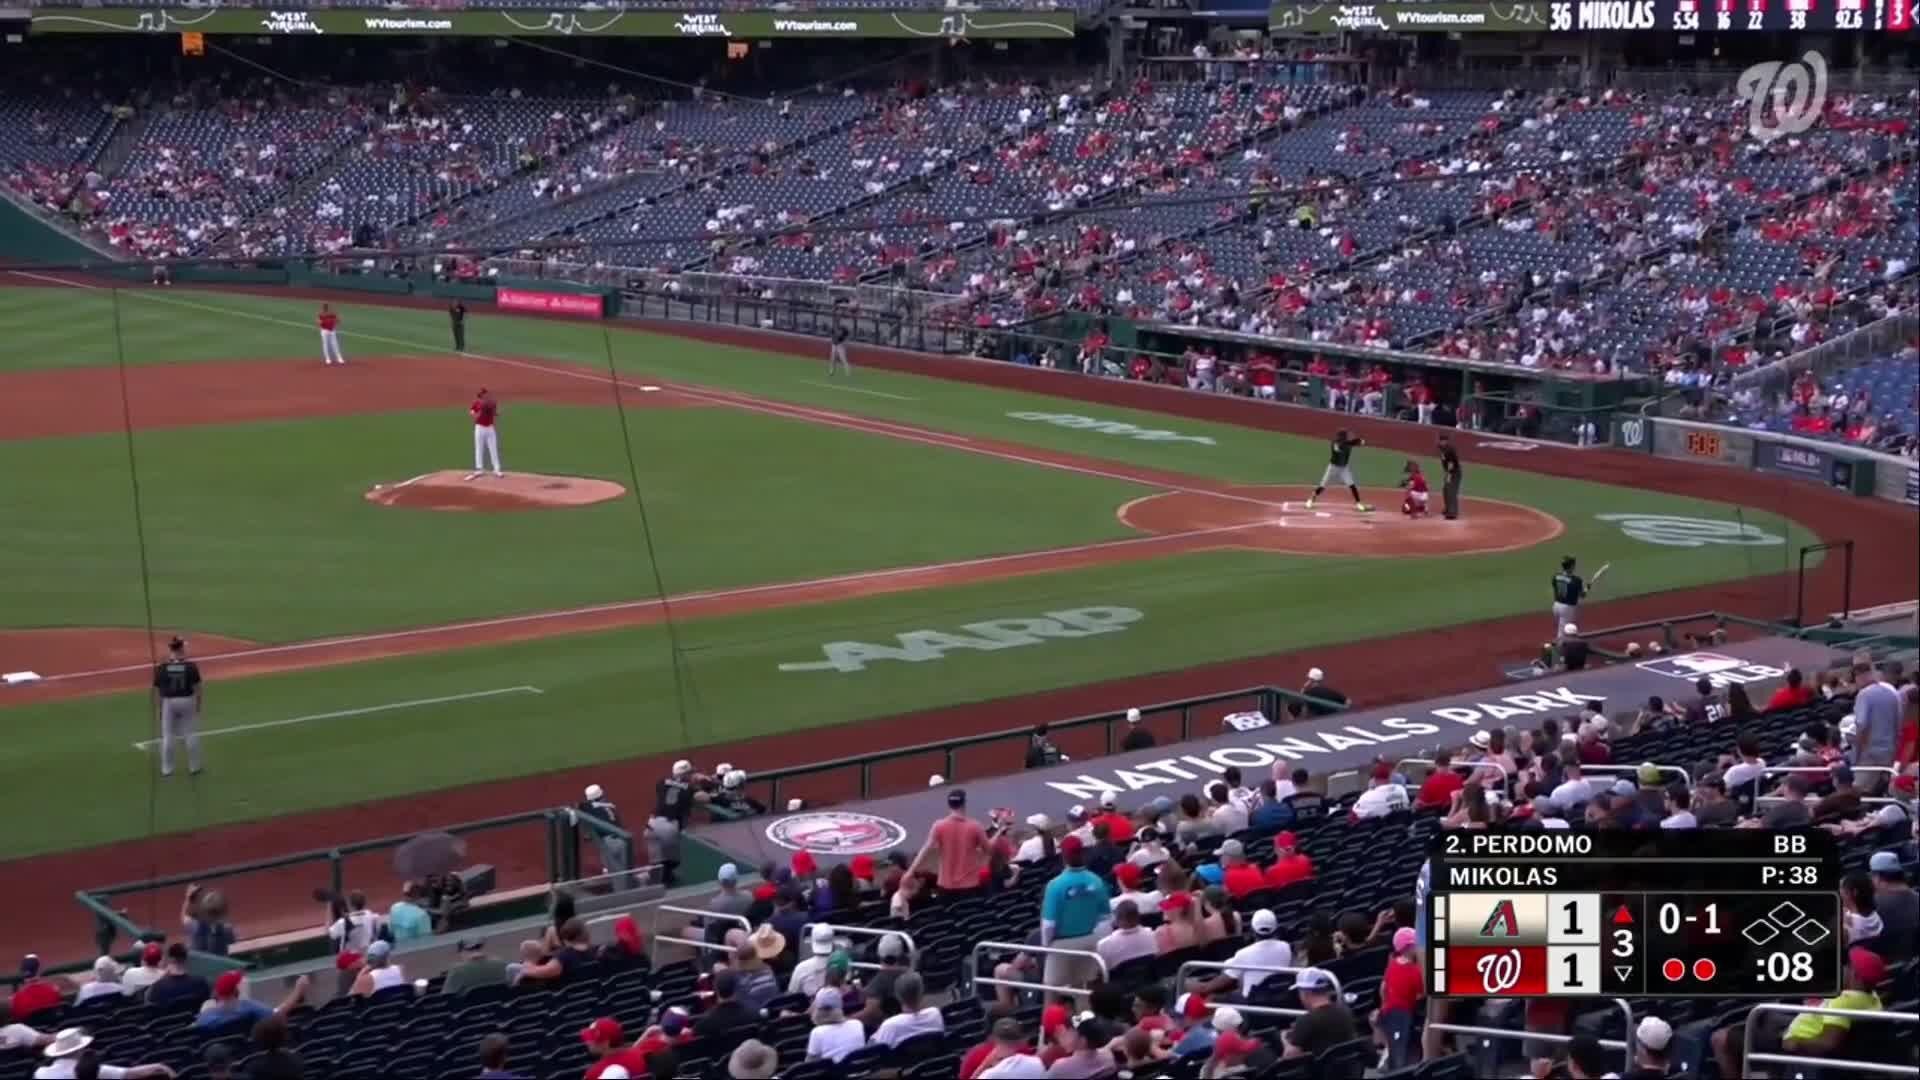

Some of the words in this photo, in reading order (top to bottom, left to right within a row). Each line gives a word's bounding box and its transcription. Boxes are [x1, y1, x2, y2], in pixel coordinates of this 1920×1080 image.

[271, 11, 307, 21] WEST
[1338, 5, 1376, 16] WEST
[1549, 3, 1572, 31] 36
[1578, 1, 1656, 30] MIKOLAS
[364, 18, 452, 29] WVtourism.com
[683, 14, 717, 24] WEST
[773, 20, 858, 31] WVtourism.com
[1330, 16, 1390, 30] VIRGINIA
[1396, 12, 1485, 25] WVtourism.com
[1673, 12, 1700, 30] 5.54
[1717, 12, 1731, 30] 16
[1747, 12, 1764, 30] 22
[1835, 11, 1863, 29] 92.6
[261, 20, 323, 34] VIRGINIA
[674, 22, 732, 36] VIRGINIA
[778, 606, 1144, 672] AARP
[1044, 716, 1440, 800] NATIONALS
[1431, 685, 1608, 726] PARK
